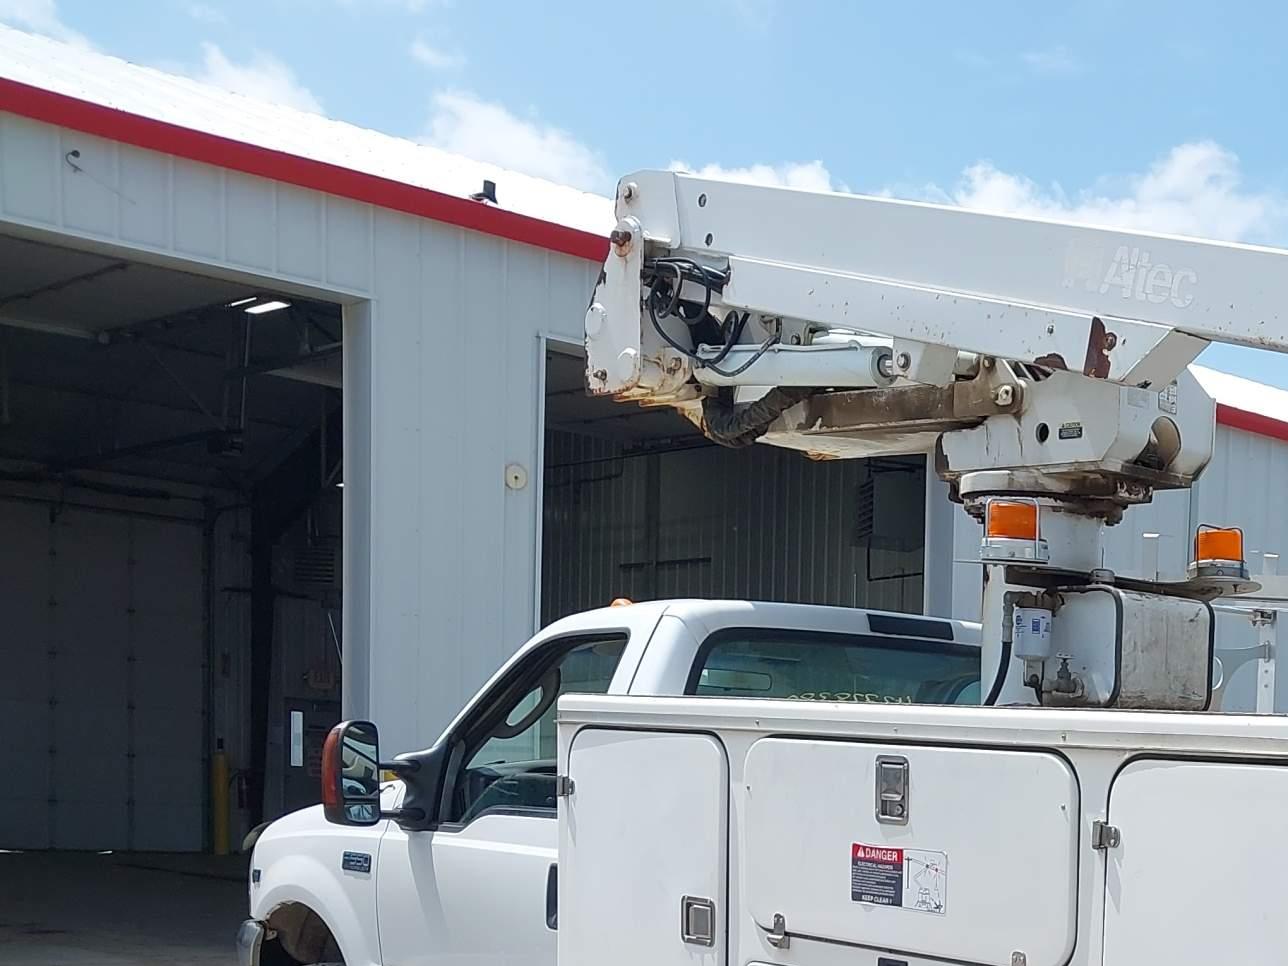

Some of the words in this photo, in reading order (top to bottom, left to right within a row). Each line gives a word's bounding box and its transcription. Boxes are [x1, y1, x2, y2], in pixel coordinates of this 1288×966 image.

[1099, 246, 1198, 308] Altec
[865, 848, 898, 861] DANGER
[874, 896, 889, 904] CLEAR
